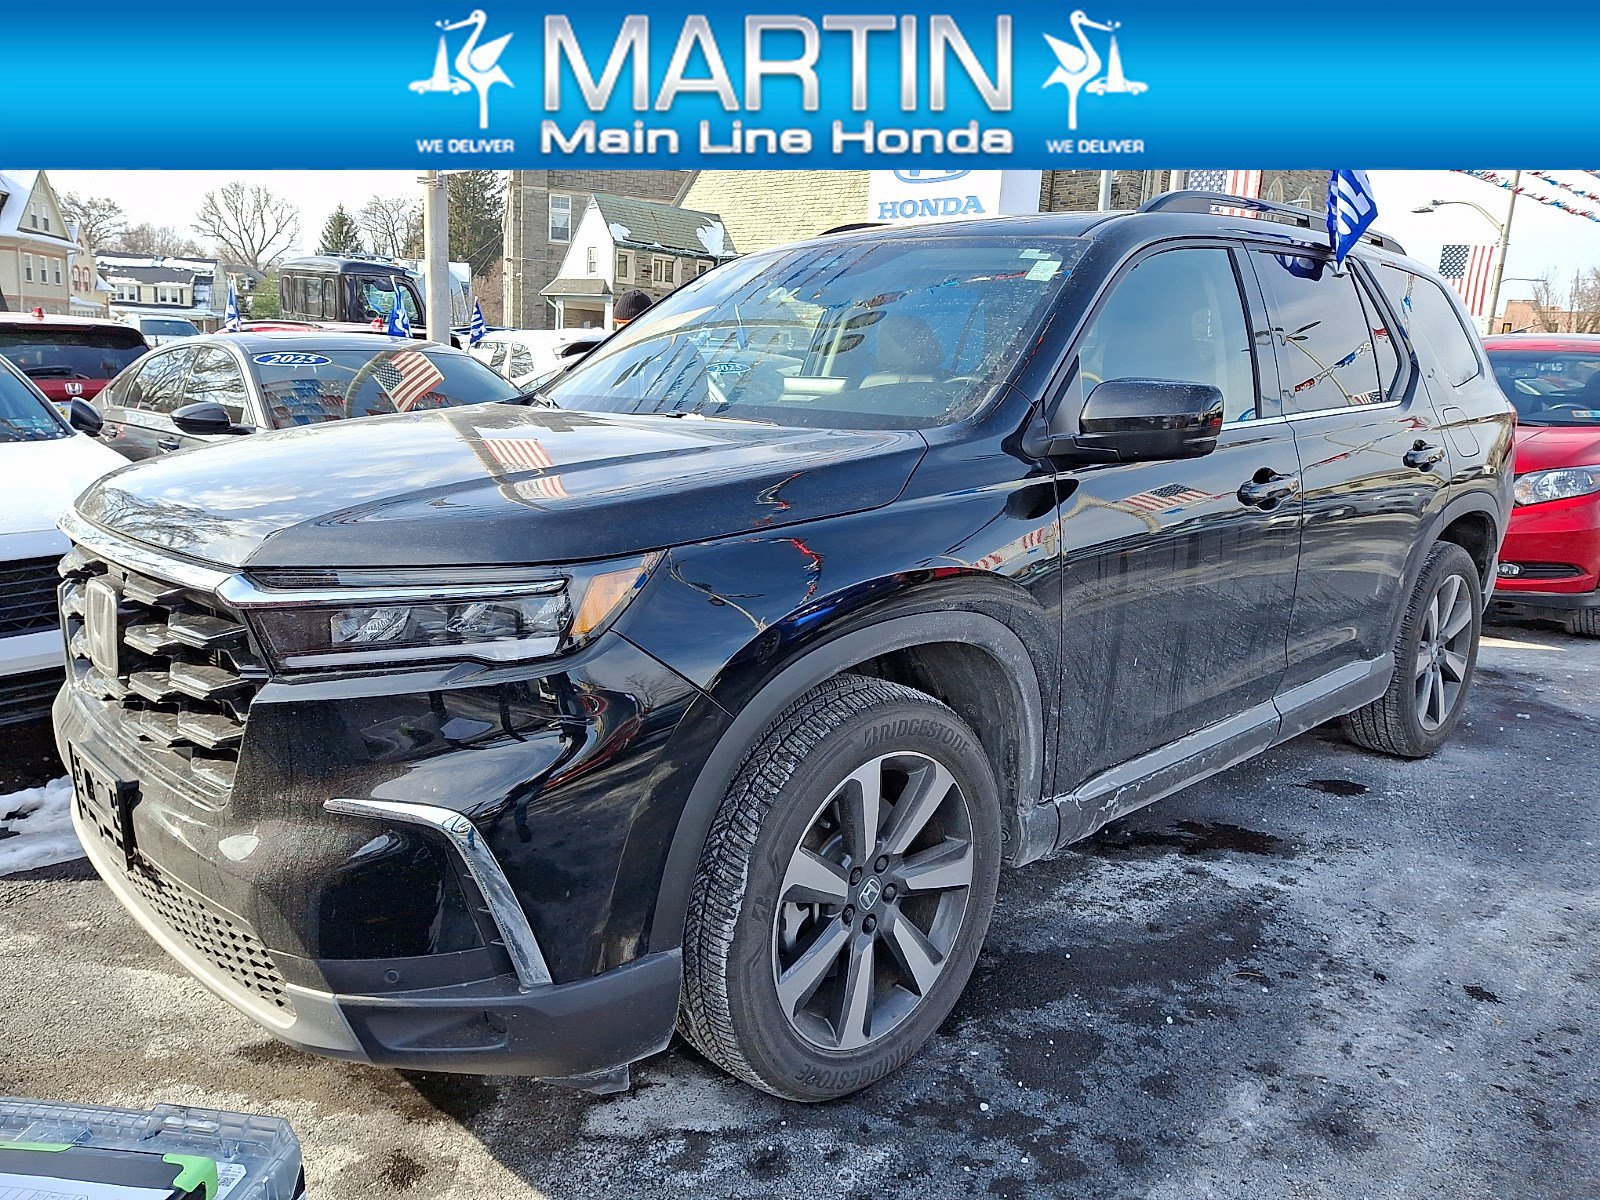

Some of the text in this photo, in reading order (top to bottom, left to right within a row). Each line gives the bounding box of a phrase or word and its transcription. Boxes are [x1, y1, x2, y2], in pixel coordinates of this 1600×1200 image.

[878, 196, 986, 219] HONDA
[268, 354, 318, 364] 2025
[864, 719, 970, 757] BRIDGESTONE
